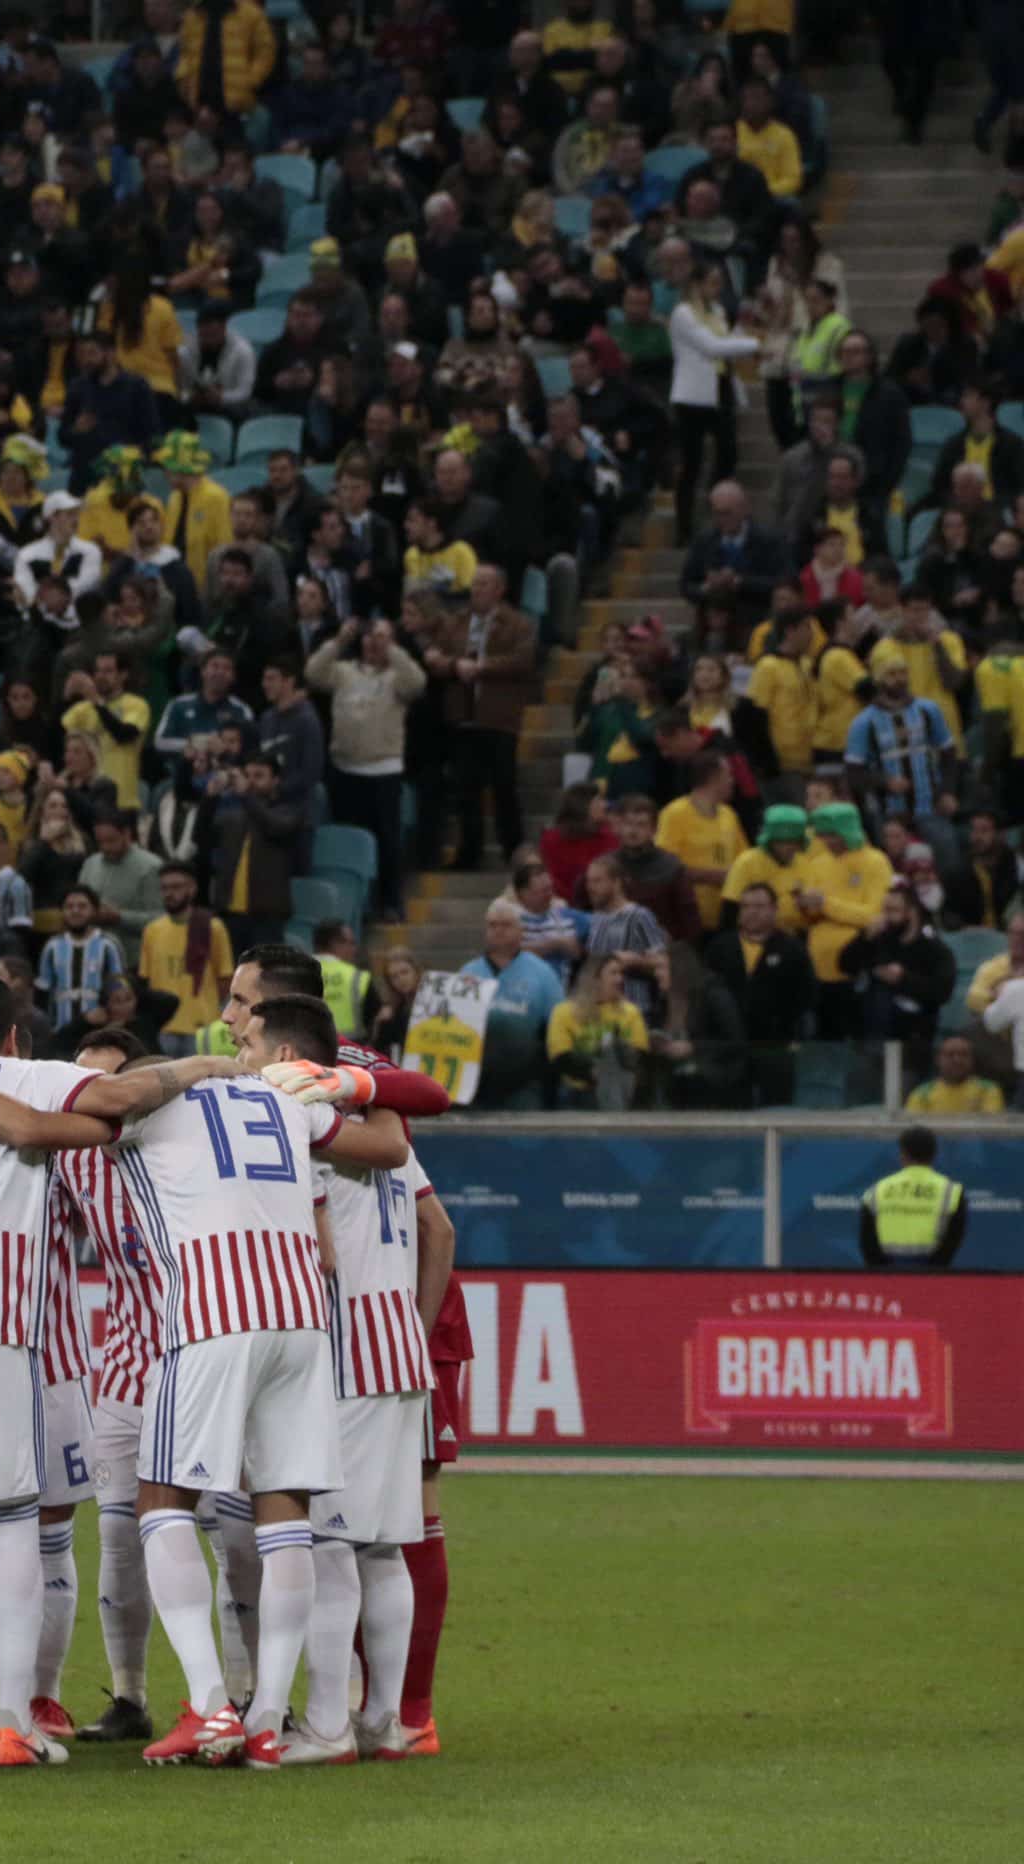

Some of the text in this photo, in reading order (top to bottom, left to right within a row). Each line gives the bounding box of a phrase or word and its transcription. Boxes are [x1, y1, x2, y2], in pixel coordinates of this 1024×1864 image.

[185, 1084, 298, 1184] 13
[717, 1336, 921, 1400] BRAHMA
[63, 1442, 89, 1487] 6
